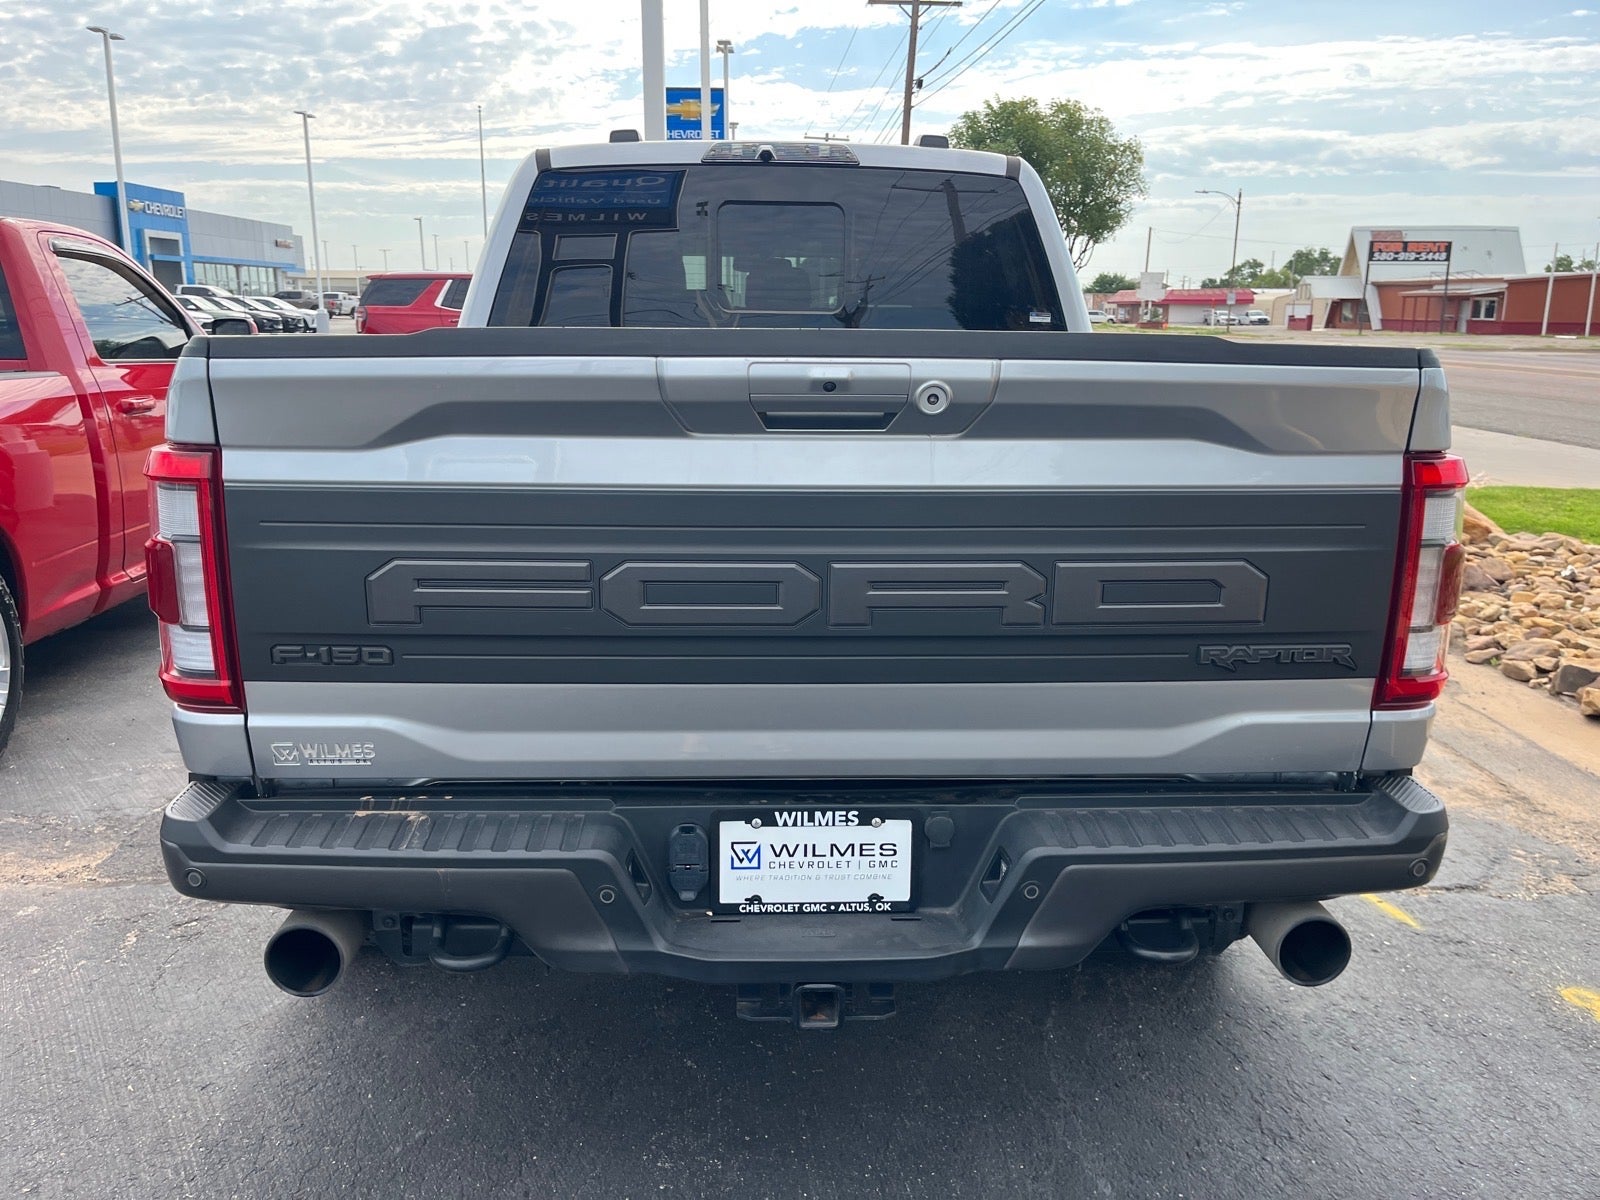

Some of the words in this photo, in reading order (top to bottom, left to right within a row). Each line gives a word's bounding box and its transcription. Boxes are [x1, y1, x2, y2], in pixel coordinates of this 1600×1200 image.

[666, 130, 720, 139] HEVROET
[144, 201, 185, 218] CHEVROLET
[1373, 242, 1403, 252] FOR
[1407, 242, 1448, 252] RENT
[365, 558, 1269, 627] FORD
[270, 644, 394, 666] F-150
[1198, 644, 1357, 671] RAPTOR
[300, 743, 376, 758] WILMES
[774, 810, 859, 827] WILMES
[769, 843, 897, 857] WILMES
[768, 860, 851, 869] CHEVROLET
[868, 860, 898, 868] GMC
[739, 904, 800, 912] CHEVROLET
[802, 903, 827, 912] GMC
[838, 903, 873, 912] ALTUS,
[875, 902, 891, 911] OK
